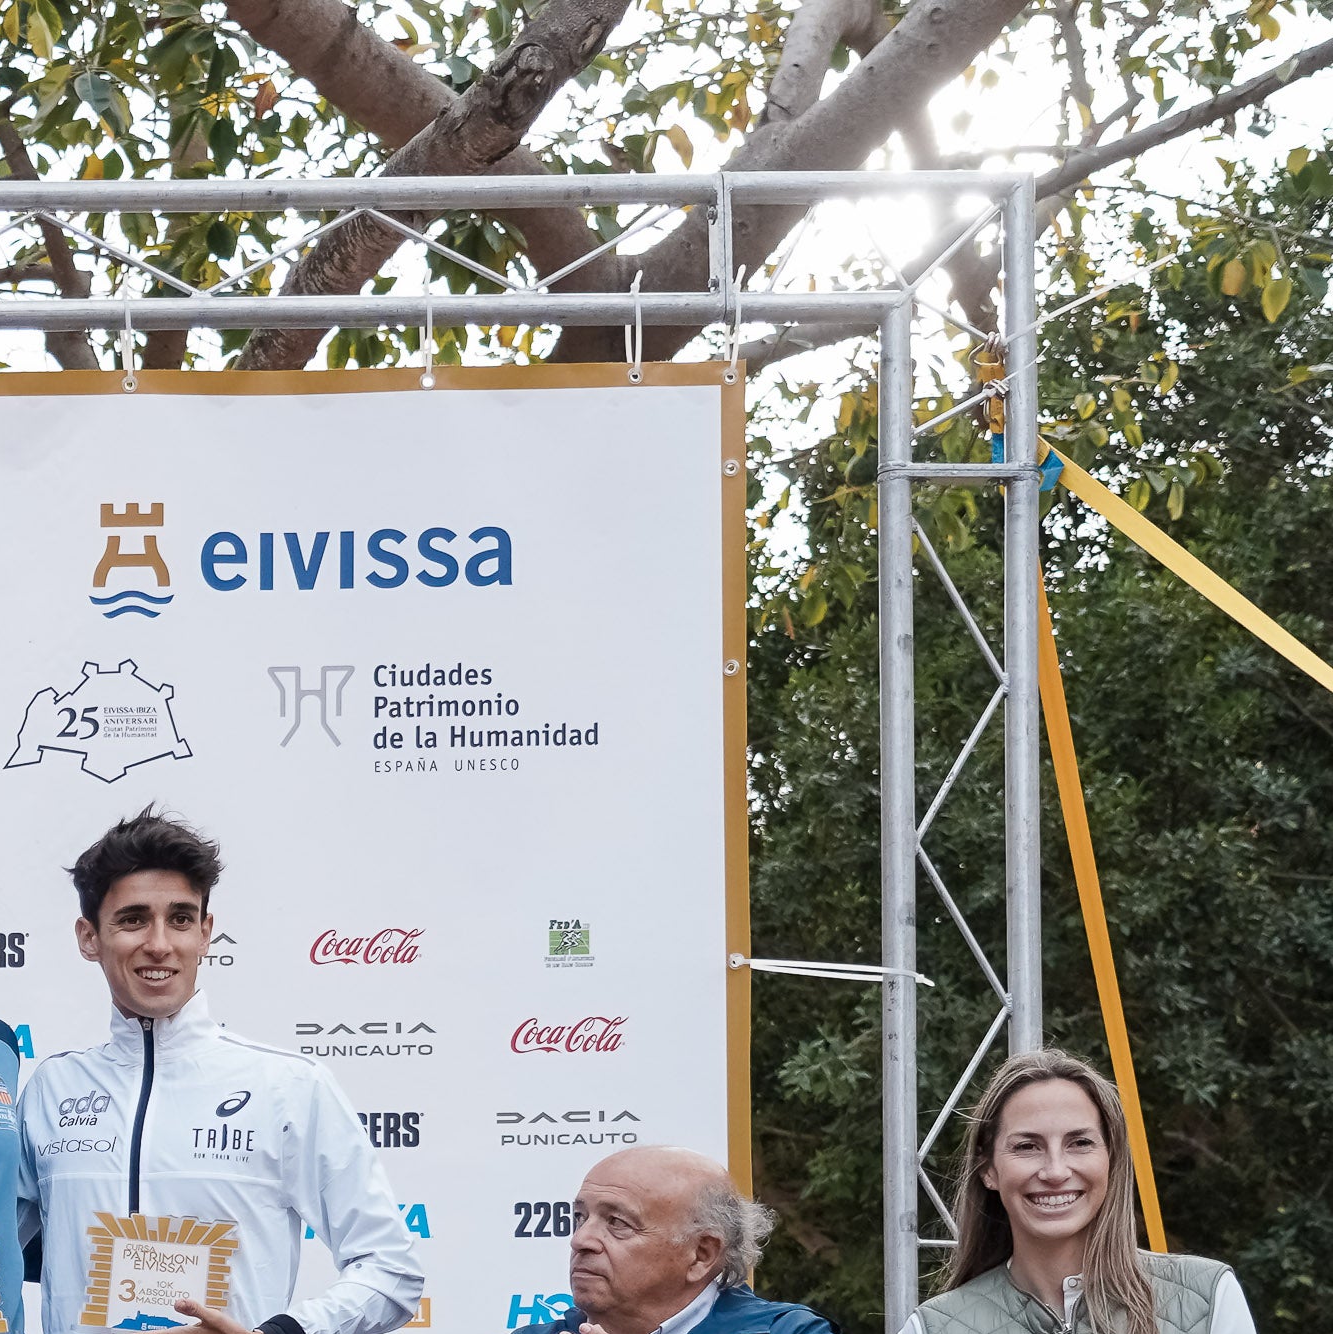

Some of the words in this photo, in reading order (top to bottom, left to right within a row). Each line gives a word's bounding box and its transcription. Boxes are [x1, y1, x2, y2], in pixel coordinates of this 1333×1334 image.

[200, 526, 513, 592] eivissa
[373, 662, 493, 688] Ciudades
[374, 692, 520, 719] Patrimonio
[56, 706, 100, 740] 25
[373, 725, 404, 750] de
[415, 725, 438, 749] la
[450, 722, 599, 748] Humanidad
[374, 757, 438, 773] ESPAÑA
[454, 758, 519, 772] UNESCO
[309, 928, 426, 966] Coca-Cola
[295, 1021, 437, 1036] DACIA
[510, 1016, 630, 1054] Coca-Cola
[298, 1043, 435, 1058] PUNICAUTO
[58, 1114, 98, 1128] Calvià
[496, 1110, 641, 1124] DACIA
[192, 1123, 255, 1152] TRIBE
[355, 1111, 422, 1149] ERS
[501, 1132, 638, 1146] PUNICAUTO
[37, 1136, 117, 1157] vistasol
[514, 1201, 576, 1238] 226
[122, 1248, 199, 1266] PATRIMONI
[133, 1259, 186, 1275] EIVISSA
[135, 1295, 177, 1307] MASCUL
[138, 1287, 190, 1299] ABSOLUTO
